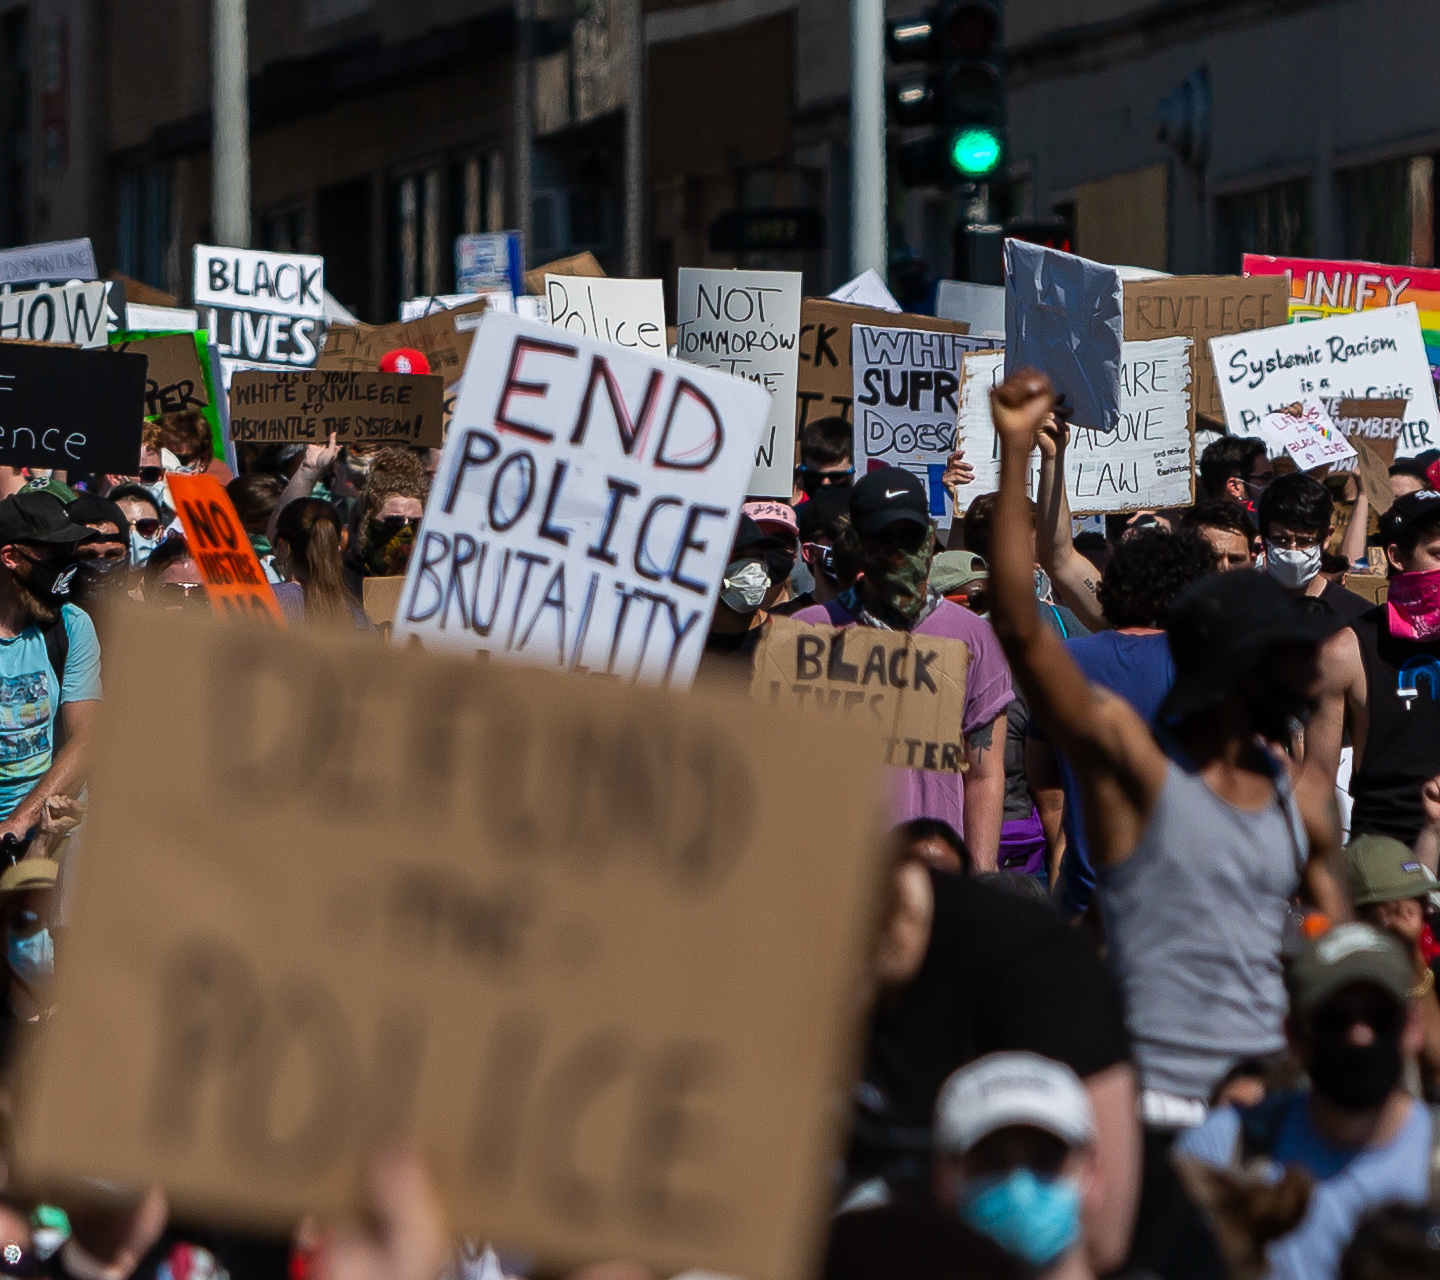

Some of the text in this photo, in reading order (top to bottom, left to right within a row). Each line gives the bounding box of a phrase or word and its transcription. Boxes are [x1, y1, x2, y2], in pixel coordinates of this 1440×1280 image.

[207, 256, 323, 306] BLACK
[695, 282, 783, 323] NOT
[1284, 268, 1410, 313] UNIFY
[207, 307, 317, 366] LIVES
[548, 280, 661, 348] Police
[1123, 292, 1274, 331] PRIVILEGE
[859, 326, 1005, 371] WHI
[1228, 345, 1324, 390] Systemic
[1325, 334, 1398, 364] Racism
[234, 381, 413, 406] WHITE PRIVILEGE
[494, 333, 725, 476] END
[857, 367, 960, 415] SUPR
[229, 418, 317, 442] DISMANTLE
[323, 417, 351, 438] THE
[1075, 460, 1140, 498] LAW
[180, 499, 240, 551] NO
[441, 426, 731, 597] POLICE
[404, 530, 705, 685] BRUTALITY
[795, 632, 940, 695] BLACK
[205, 635, 763, 900] DEFUND
[882, 735, 963, 774] TTER
[148, 933, 737, 1236] POLICE
